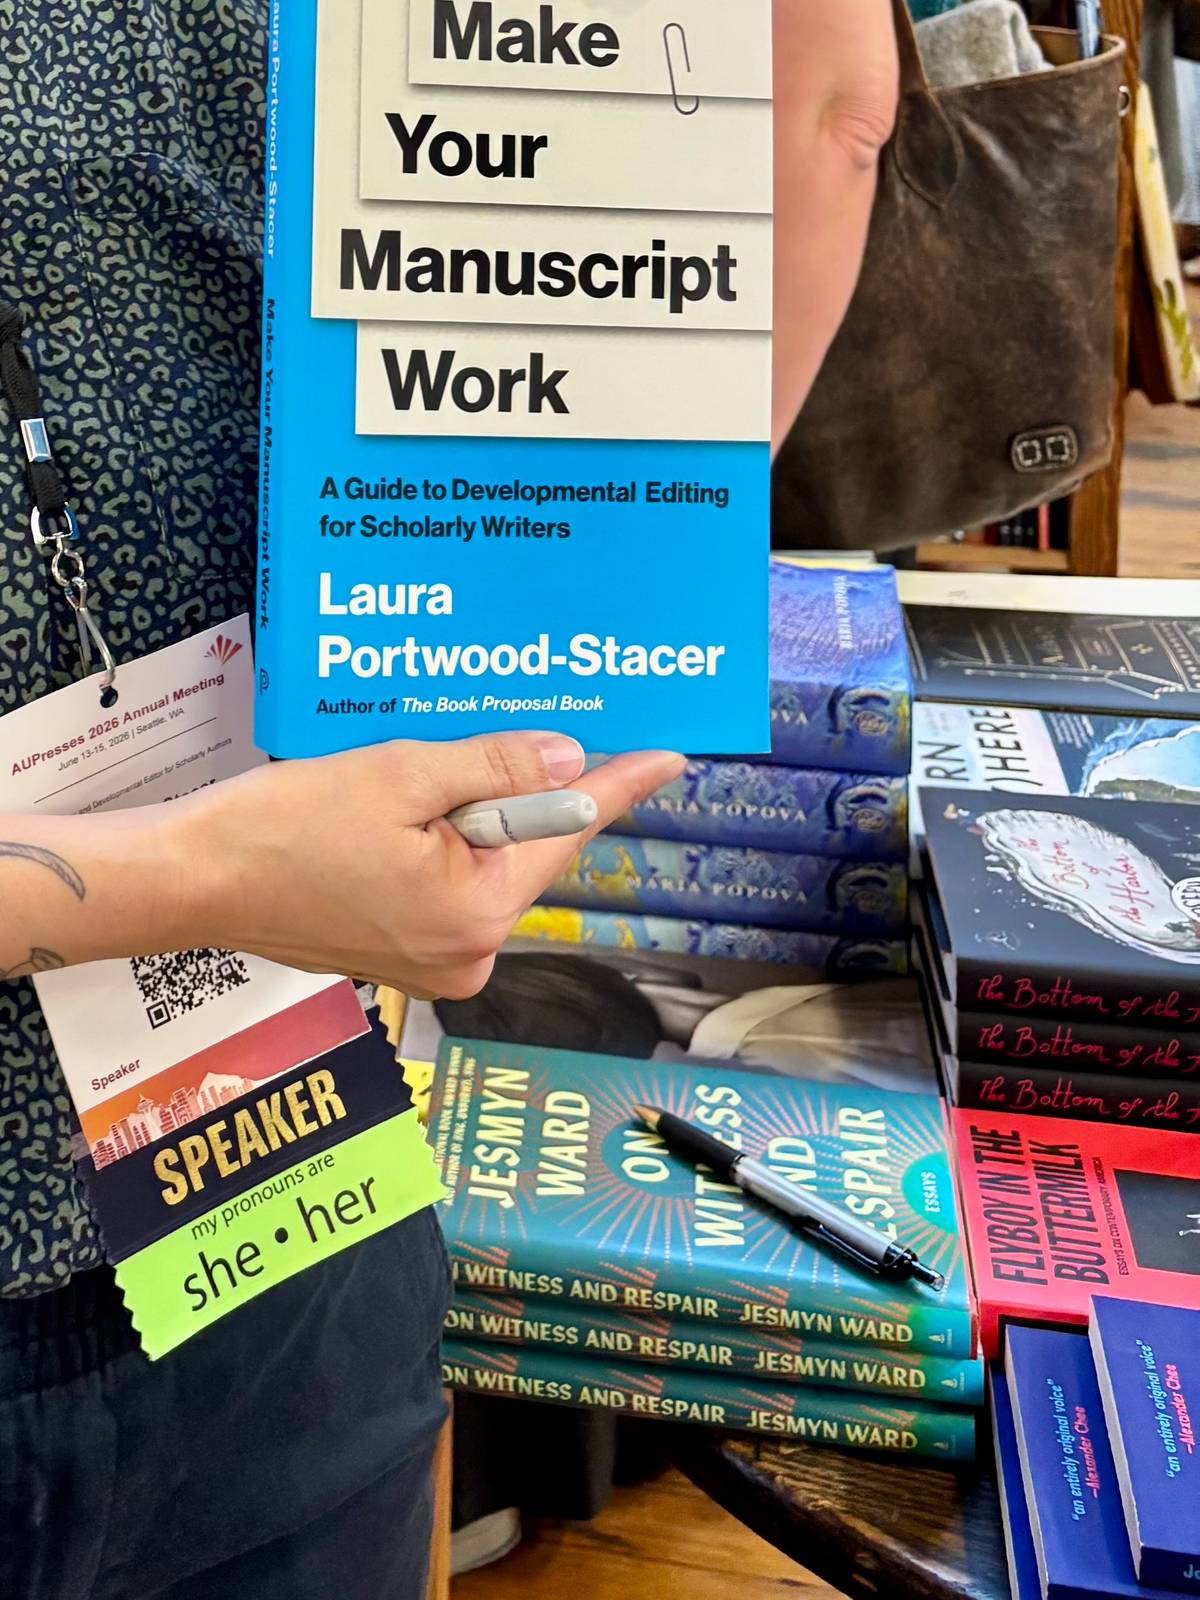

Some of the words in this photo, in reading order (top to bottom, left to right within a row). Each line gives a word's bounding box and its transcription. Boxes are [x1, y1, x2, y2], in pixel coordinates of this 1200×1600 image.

[433, 0, 620, 67] Make
[267, 57, 280, 258] Portwood-Stacer
[385, 113, 547, 179] Your
[340, 229, 737, 314] Manuscript
[265, 298, 275, 362] Make
[264, 367, 274, 421] Your
[381, 349, 570, 414] Work
[261, 425, 273, 561] Manuscript
[320, 478, 339, 500] A
[345, 478, 417, 501] Guide
[423, 480, 446, 500] to
[452, 479, 636, 506] Developmental
[645, 481, 729, 508] Editing
[320, 515, 355, 538] for
[360, 515, 477, 542] Scholarly
[481, 516, 571, 539] Writers
[259, 565, 270, 631] Work
[319, 572, 453, 615] Laura
[318, 633, 725, 678] Portwood-Stacer
[11, 734, 86, 776] AUPresses
[88, 716, 120, 740] 2026
[122, 695, 170, 728] Annual
[172, 673, 225, 703] Meeting
[316, 698, 374, 714] Author
[379, 698, 397, 713] of
[402, 696, 433, 713] The
[436, 695, 478, 713] Book
[481, 695, 557, 715] Proposal
[560, 694, 604, 712] Book
[57, 755, 79, 772] June
[80, 742, 107, 760] 13-15,
[108, 731, 130, 748] 2026
[168, 707, 185, 721] WA
[92, 779, 144, 810] Developmental
[143, 772, 163, 789] Editor
[163, 766, 175, 778] for
[174, 750, 206, 775] Scholarly
[206, 737, 232, 757] Authors
[711, 801, 808, 824] POPOVA
[625, 875, 701, 894] MARIA
[712, 881, 808, 905] POPOVA
[977, 974, 1004, 1000] The
[1006, 976, 1110, 1012] Bottom
[1117, 996, 1143, 1017] of
[1142, 991, 1180, 1017] the
[447, 1045, 463, 1076] WINNER
[978, 1023, 1005, 1049] The
[1006, 1024, 1111, 1063] Bottom
[1117, 1045, 1143, 1066] of
[1142, 1039, 1180, 1067] the
[91, 1058, 141, 1092] Speaker
[442, 1077, 458, 1107] AWARD
[979, 1075, 1006, 1101] The
[1008, 1077, 1111, 1115] Bottom
[1118, 1098, 1143, 1118] of
[1142, 1091, 1180, 1119] the
[153, 1069, 347, 1206] SPEAKER
[438, 1109, 453, 1131] BOOK
[468, 1066, 530, 1209] JESMYN
[450, 1143, 462, 1153] OF
[536, 1090, 590, 1196] WARD
[621, 1129, 670, 1183] ON
[969, 1125, 1026, 1165] THE
[446, 1154, 460, 1186] AUTHOR
[924, 1170, 941, 1213] ESSAYS
[976, 1170, 1032, 1196] IN
[1091, 1156, 1106, 1185] AMERICA
[191, 1212, 219, 1241] my
[221, 1169, 305, 1227] pronouns
[306, 1152, 335, 1177] are
[1028, 1140, 1110, 1285] BUTTERMILK
[1100, 1186, 1119, 1236] CONTEMPORARY
[183, 1239, 265, 1313] she
[296, 1175, 377, 1243] her
[981, 1195, 1048, 1286] FLYBOY
[1111, 1237, 1123, 1248] ON
[1113, 1249, 1129, 1276] ESSAYS
[464, 1263, 563, 1295] WITNESS
[569, 1279, 618, 1303] AND
[624, 1286, 719, 1318] RESPAIR
[739, 1303, 833, 1333] JESMYN
[839, 1316, 914, 1343] WARD
[443, 1310, 474, 1330] ON
[480, 1313, 579, 1345] WITNESS
[584, 1328, 632, 1352] AND
[638, 1336, 734, 1366] RESPAIR
[754, 1350, 847, 1381] JESMYN
[853, 1362, 927, 1389] WARD
[1149, 1372, 1167, 1410] original
[1165, 1363, 1182, 1389] Chee
[441, 1364, 469, 1385] ON
[474, 1368, 572, 1400] WITNESS
[578, 1385, 626, 1408] AND
[631, 1393, 726, 1424] RESPAIR
[746, 1410, 839, 1440] JESMYN
[845, 1423, 919, 1450] WARD
[1074, 1406, 1090, 1434] Chee
[1055, 1415, 1074, 1455] original
[1154, 1412, 1177, 1453] entirely
[1061, 1456, 1080, 1497] entirely
